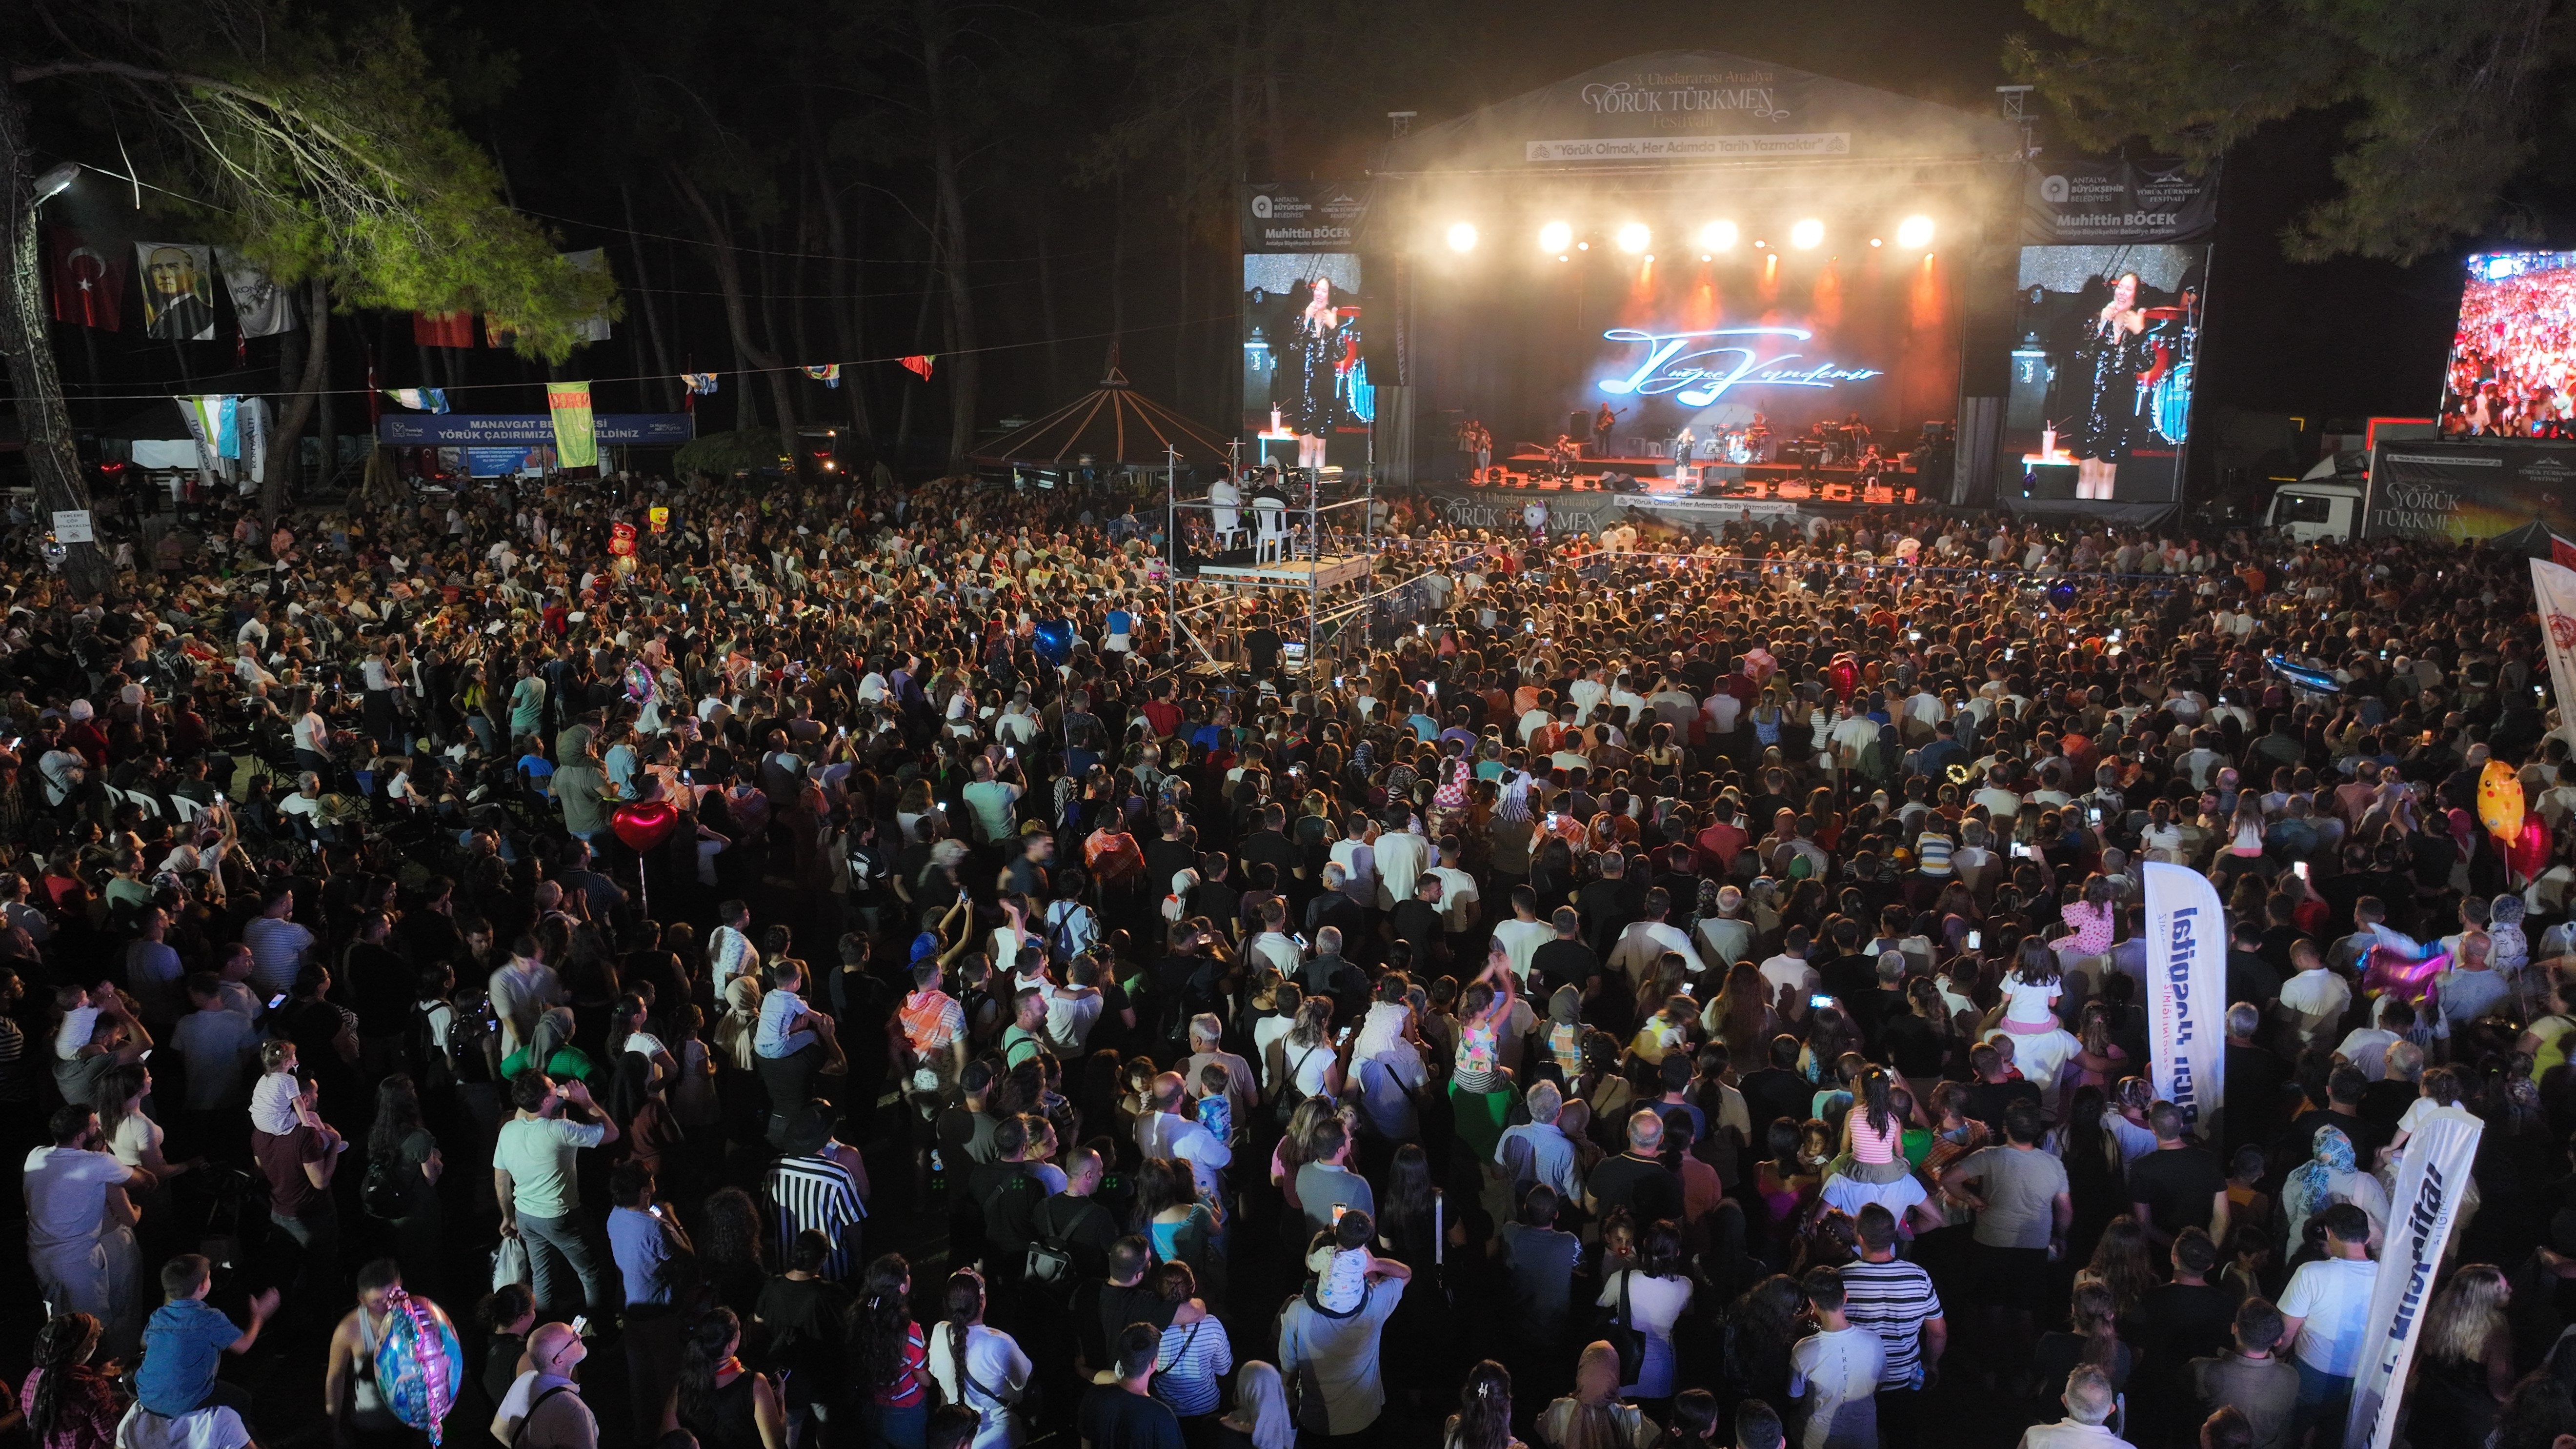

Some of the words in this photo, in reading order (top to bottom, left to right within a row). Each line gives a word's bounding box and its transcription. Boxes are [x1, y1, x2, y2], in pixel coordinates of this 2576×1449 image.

[1648, 72, 1723, 85] Uluslararası
[1726, 70, 1773, 85] Antalya
[1582, 82, 1663, 113] YÖRÜK
[1669, 86, 1790, 122] TÜRKMEN
[1595, 142, 1638, 156] Olmak,
[1642, 142, 1662, 153] Her
[1667, 141, 1715, 153] Adımda
[1719, 140, 1750, 152] Tarih
[2071, 184, 2124, 195] BÜYÜKŞEHİR
[2071, 194, 2112, 202] BELEDİYESİ
[2056, 214, 2121, 226] Muhittin
[2124, 211, 2176, 226] BÖCEK
[1265, 228, 1312, 238] Muhittin
[1313, 225, 1351, 238] BÖCEK
[438, 429, 481, 439] YÖRÜK
[484, 431, 554, 441] ÇADIRIMIZA
[595, 428, 639, 438] ELDİNİZ
[1558, 495, 1599, 510] Antalya
[2386, 482, 2460, 511] YÖRÜK
[1654, 499, 1678, 508] Olmak,
[1694, 501, 1722, 509] Adımda
[1724, 502, 1741, 510] Tarih
